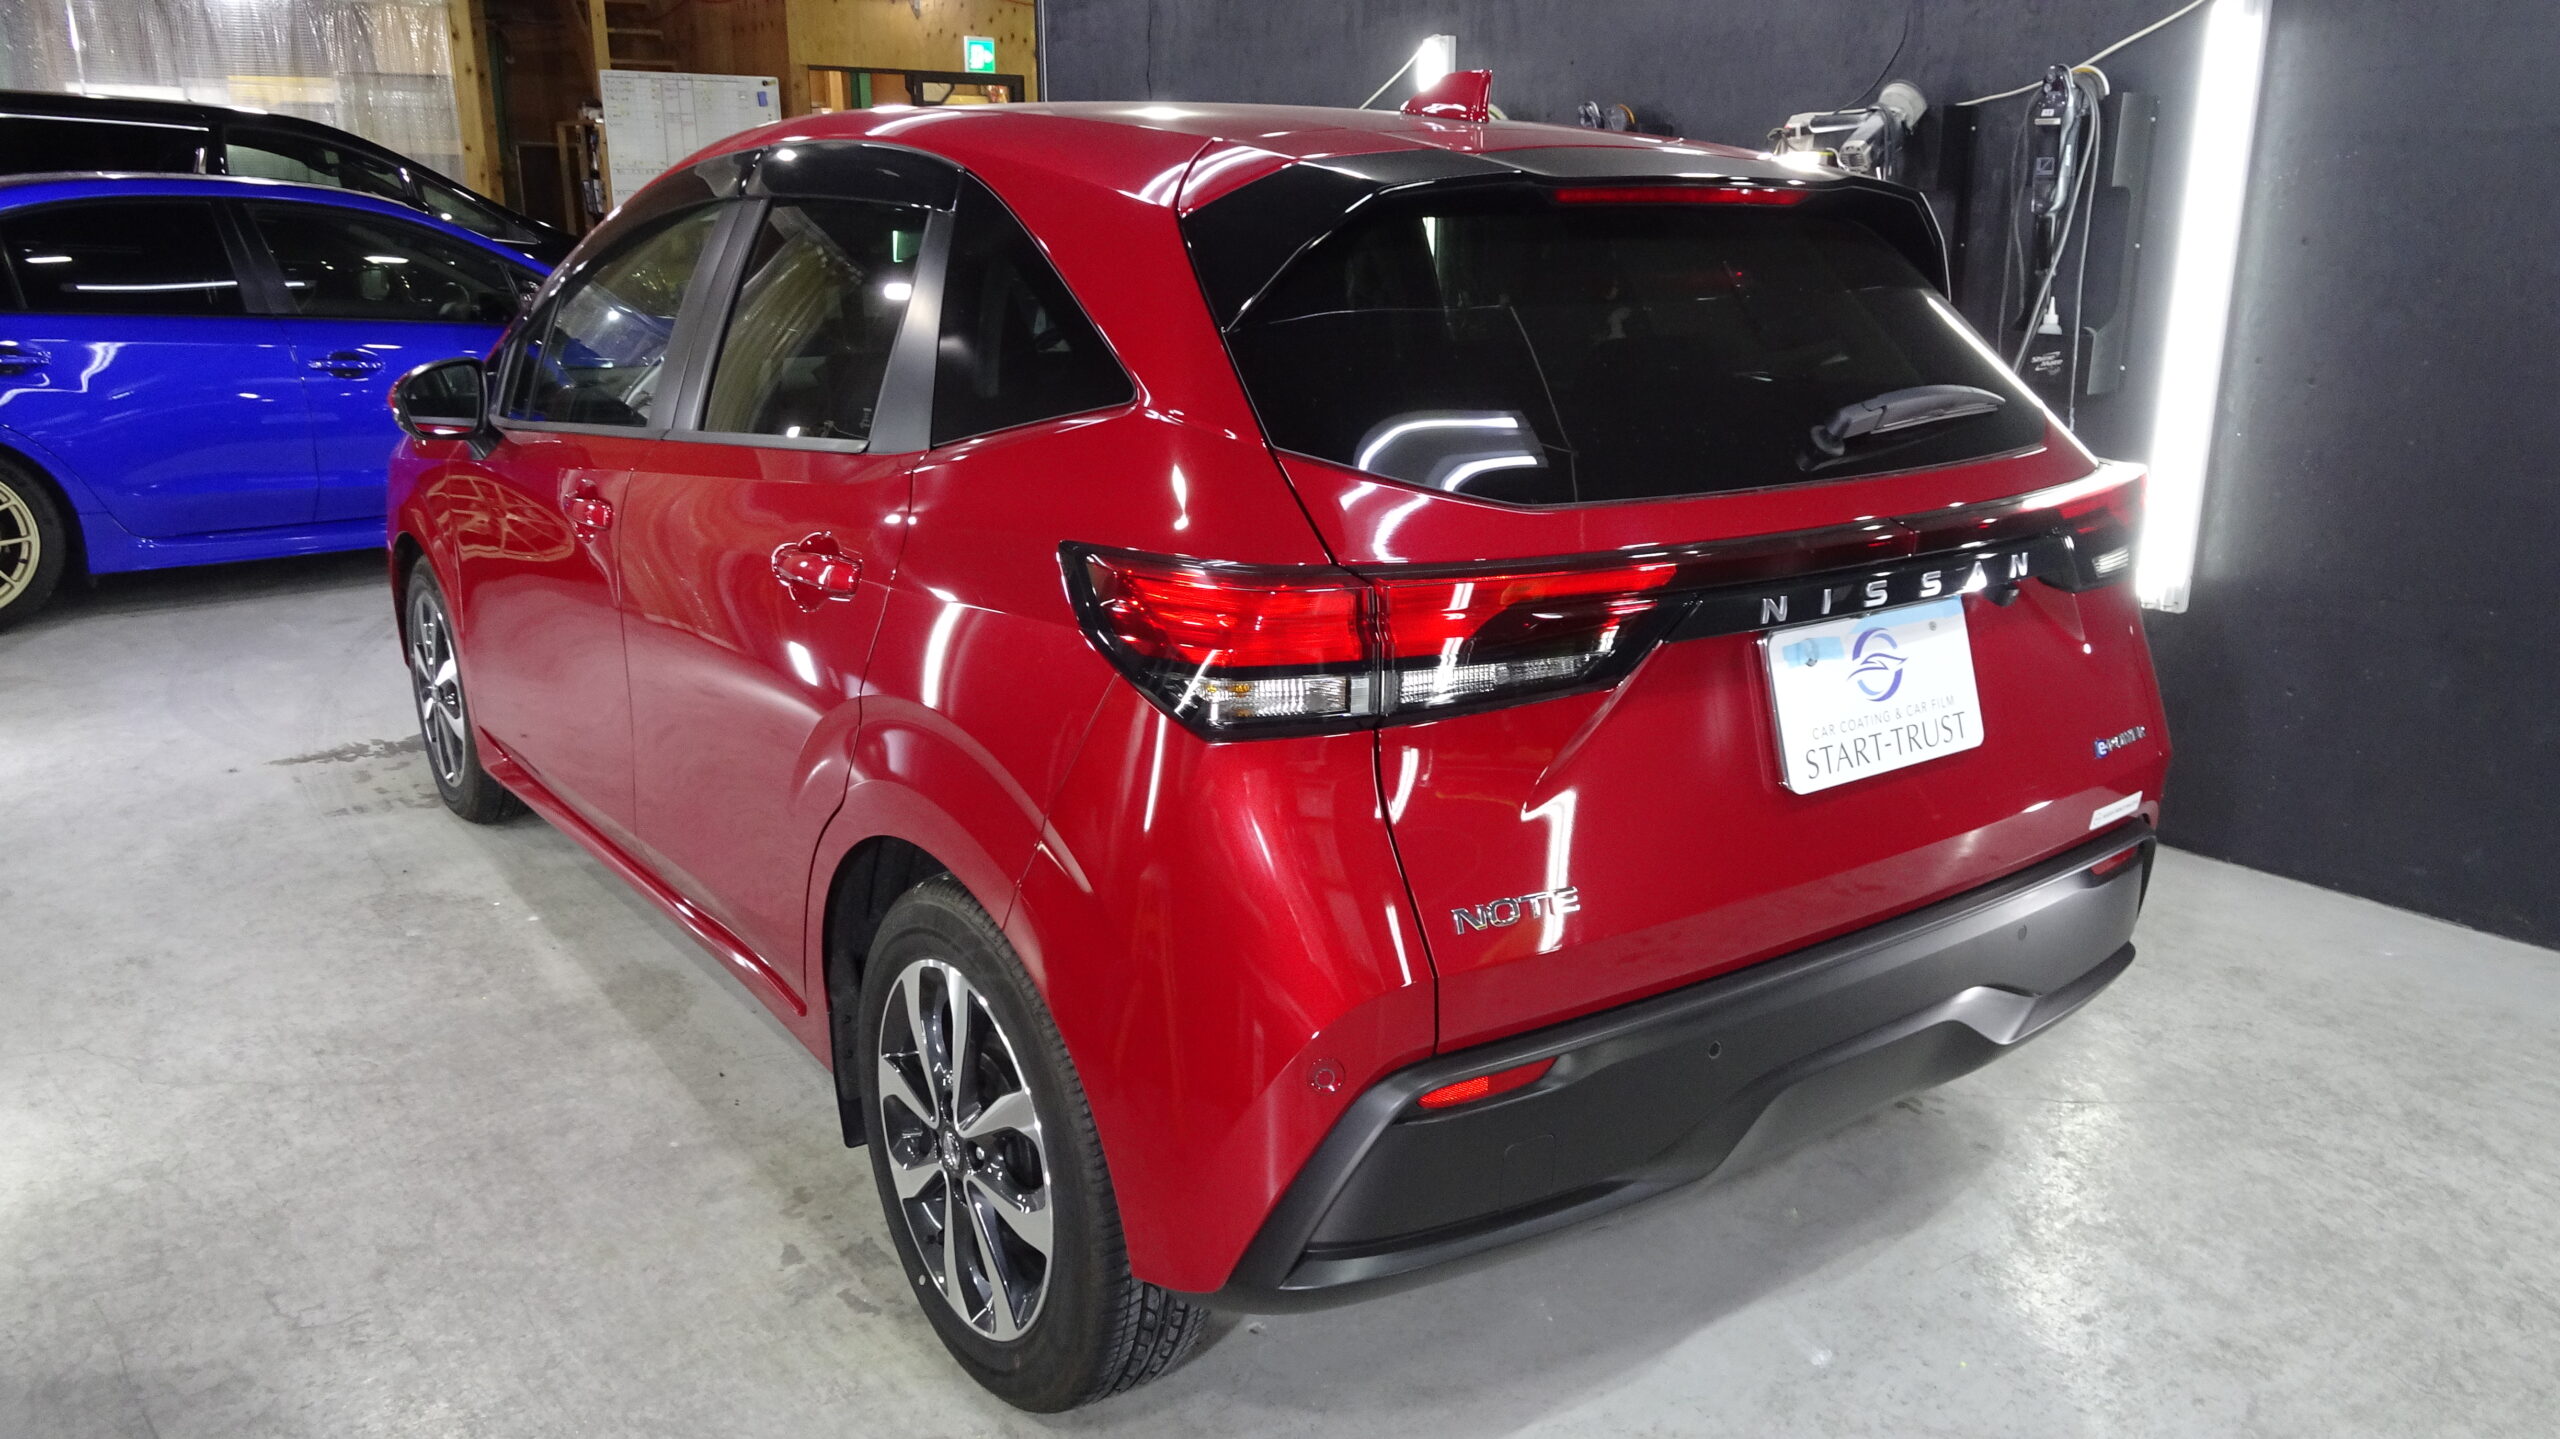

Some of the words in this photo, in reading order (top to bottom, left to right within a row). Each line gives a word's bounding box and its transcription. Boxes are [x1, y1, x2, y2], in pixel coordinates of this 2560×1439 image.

[1761, 552, 2029, 625] NISSAN
[1805, 711, 1965, 780] START-TRUST
[1812, 724, 1836, 741] CAR
[1839, 711, 1892, 734] COATING
[1895, 707, 1903, 720] &
[1905, 701, 1928, 717] CAR
[1931, 695, 1956, 709] FILM
[1451, 886, 1581, 935] NOTE
